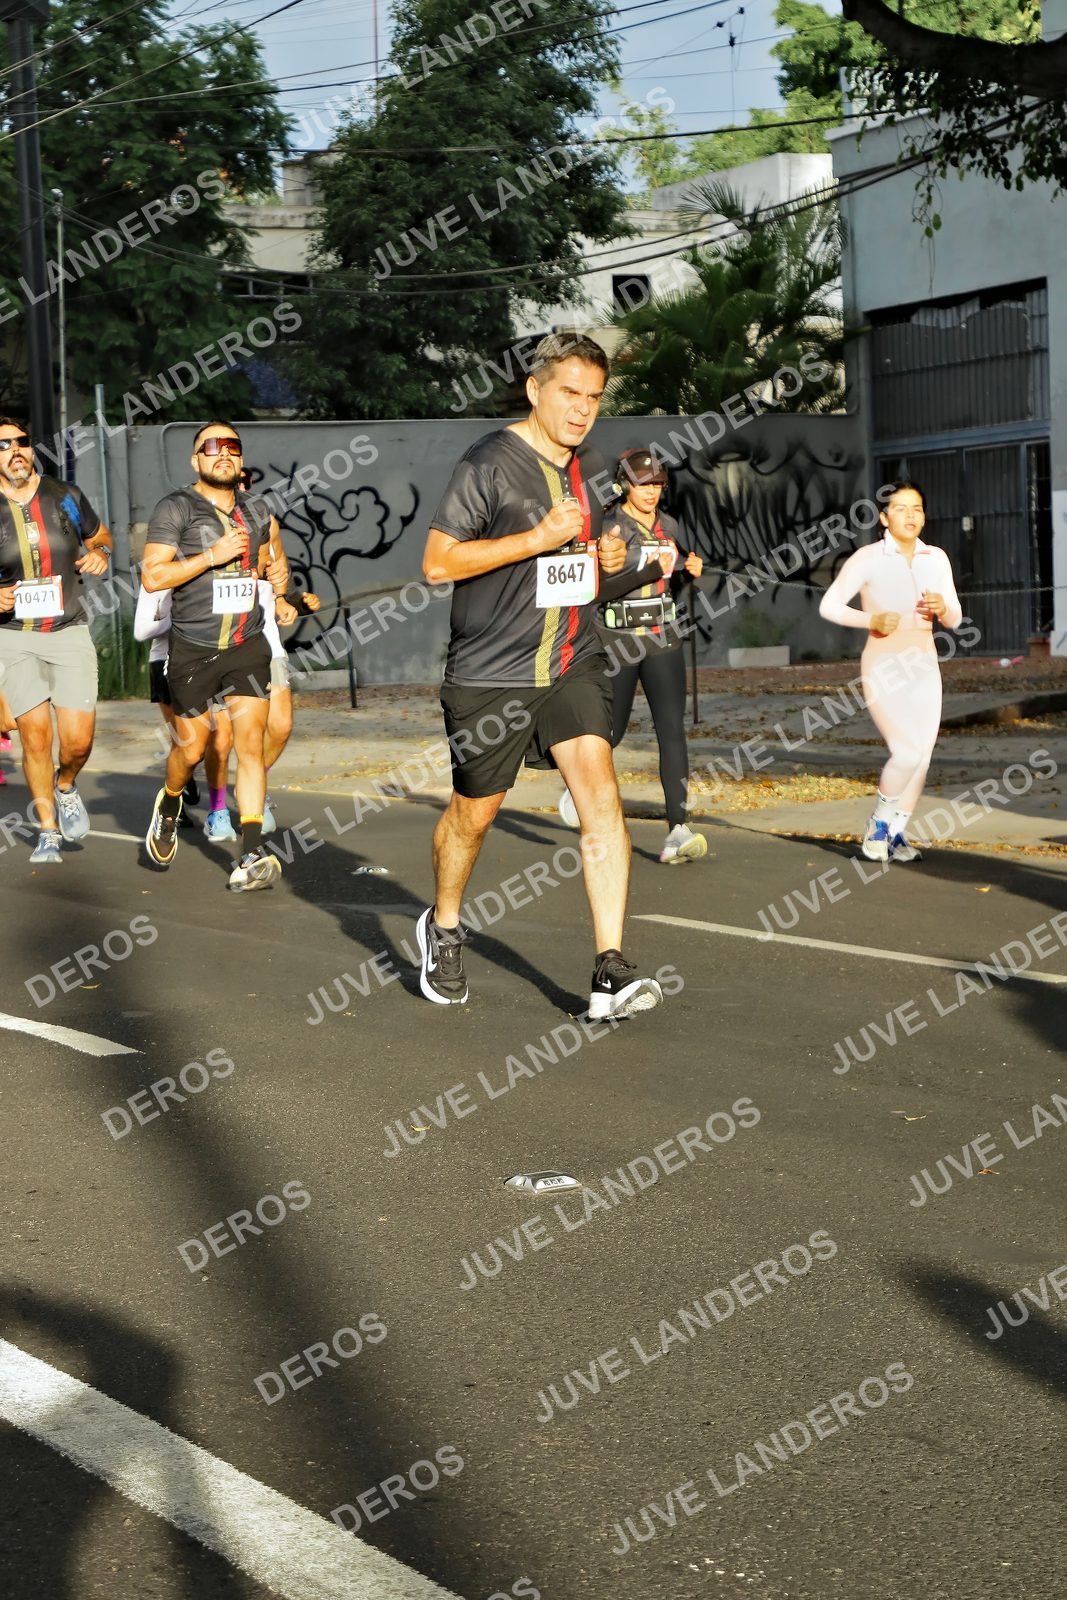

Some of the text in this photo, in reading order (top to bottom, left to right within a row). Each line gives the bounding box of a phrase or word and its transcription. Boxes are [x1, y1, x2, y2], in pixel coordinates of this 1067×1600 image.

[547, 562, 585, 585] 8647
[15, 590, 55, 604] 10471
[217, 583, 253, 598] 11123
